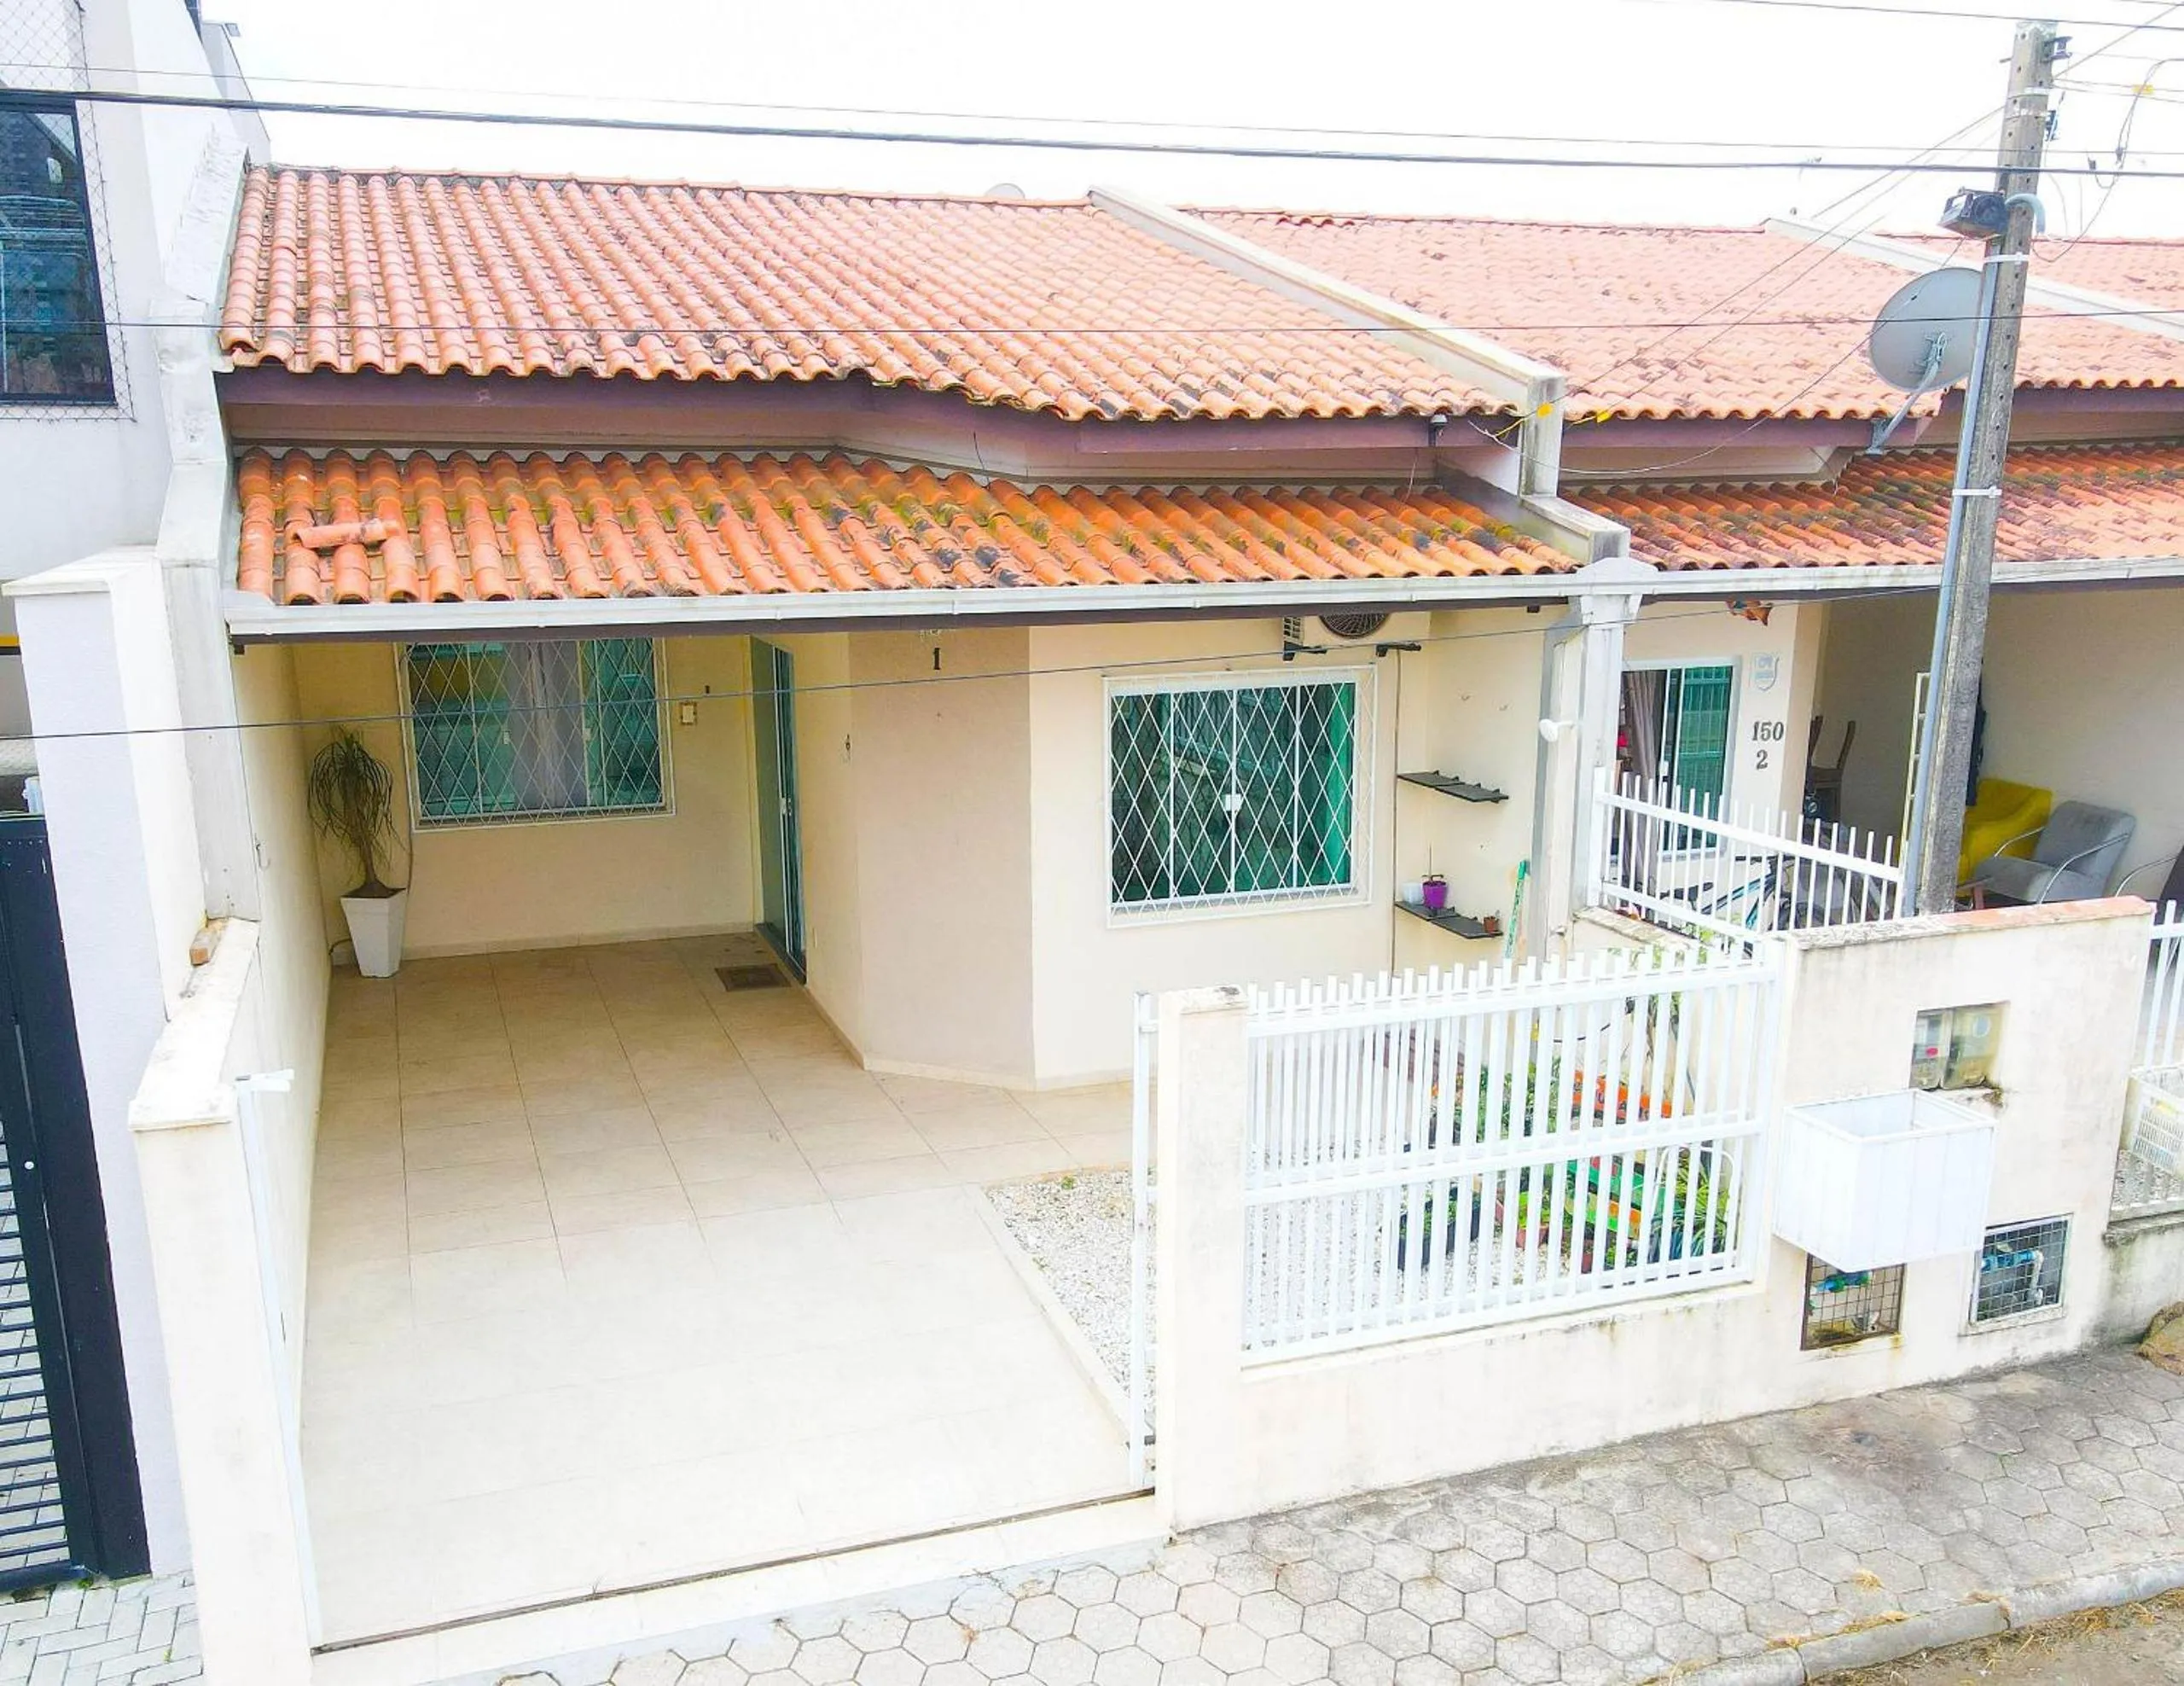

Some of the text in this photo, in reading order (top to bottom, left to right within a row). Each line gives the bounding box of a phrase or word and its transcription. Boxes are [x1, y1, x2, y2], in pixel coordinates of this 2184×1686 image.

[933, 647, 941, 671] 1
[1751, 721, 1785, 741] 150
[1756, 749, 1769, 770] 2
